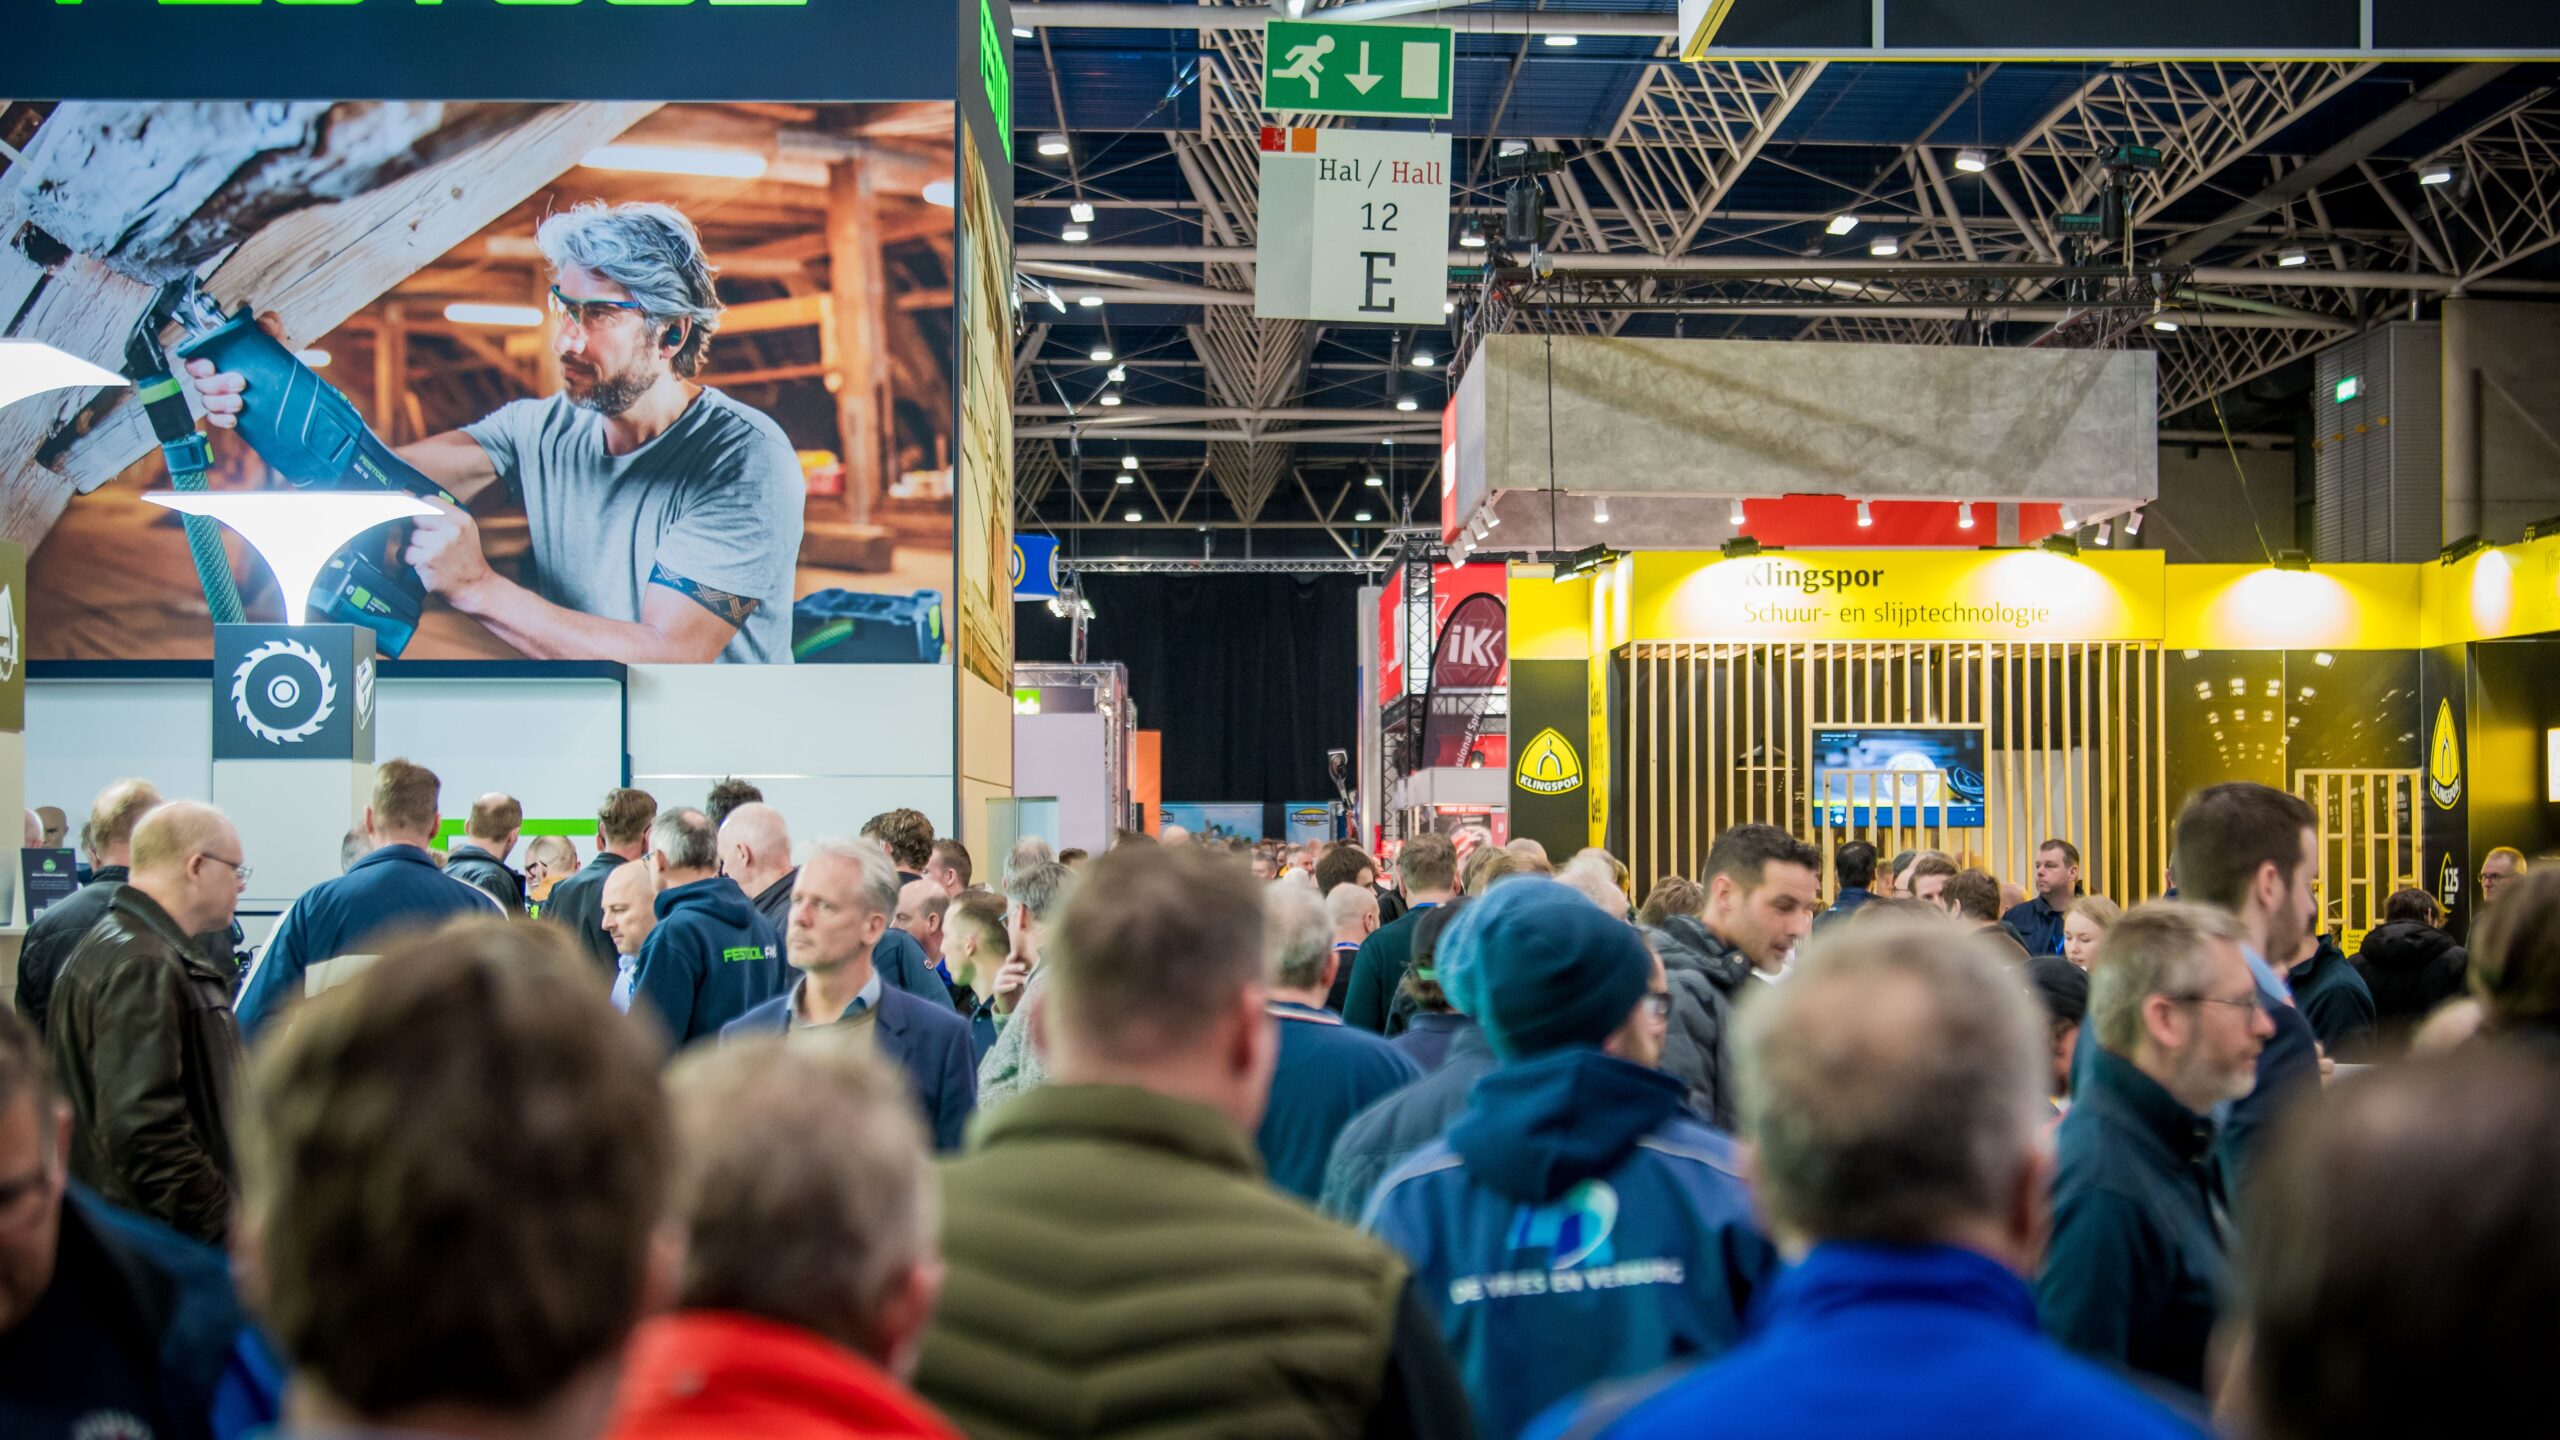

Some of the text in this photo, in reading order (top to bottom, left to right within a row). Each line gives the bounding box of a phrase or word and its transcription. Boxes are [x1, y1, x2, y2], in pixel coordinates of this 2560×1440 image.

[1319, 158, 1361, 182] Hal
[1391, 161, 1442, 185] Hall
[1361, 202, 1398, 231] 12
[1358, 251, 1396, 313] E
[1745, 562, 1885, 594] Klingspor
[1744, 602, 2049, 628] Schuur- en slijptechnologie
[1520, 775, 1579, 792] KLINGSPOR
[2444, 867, 2459, 893] 125
